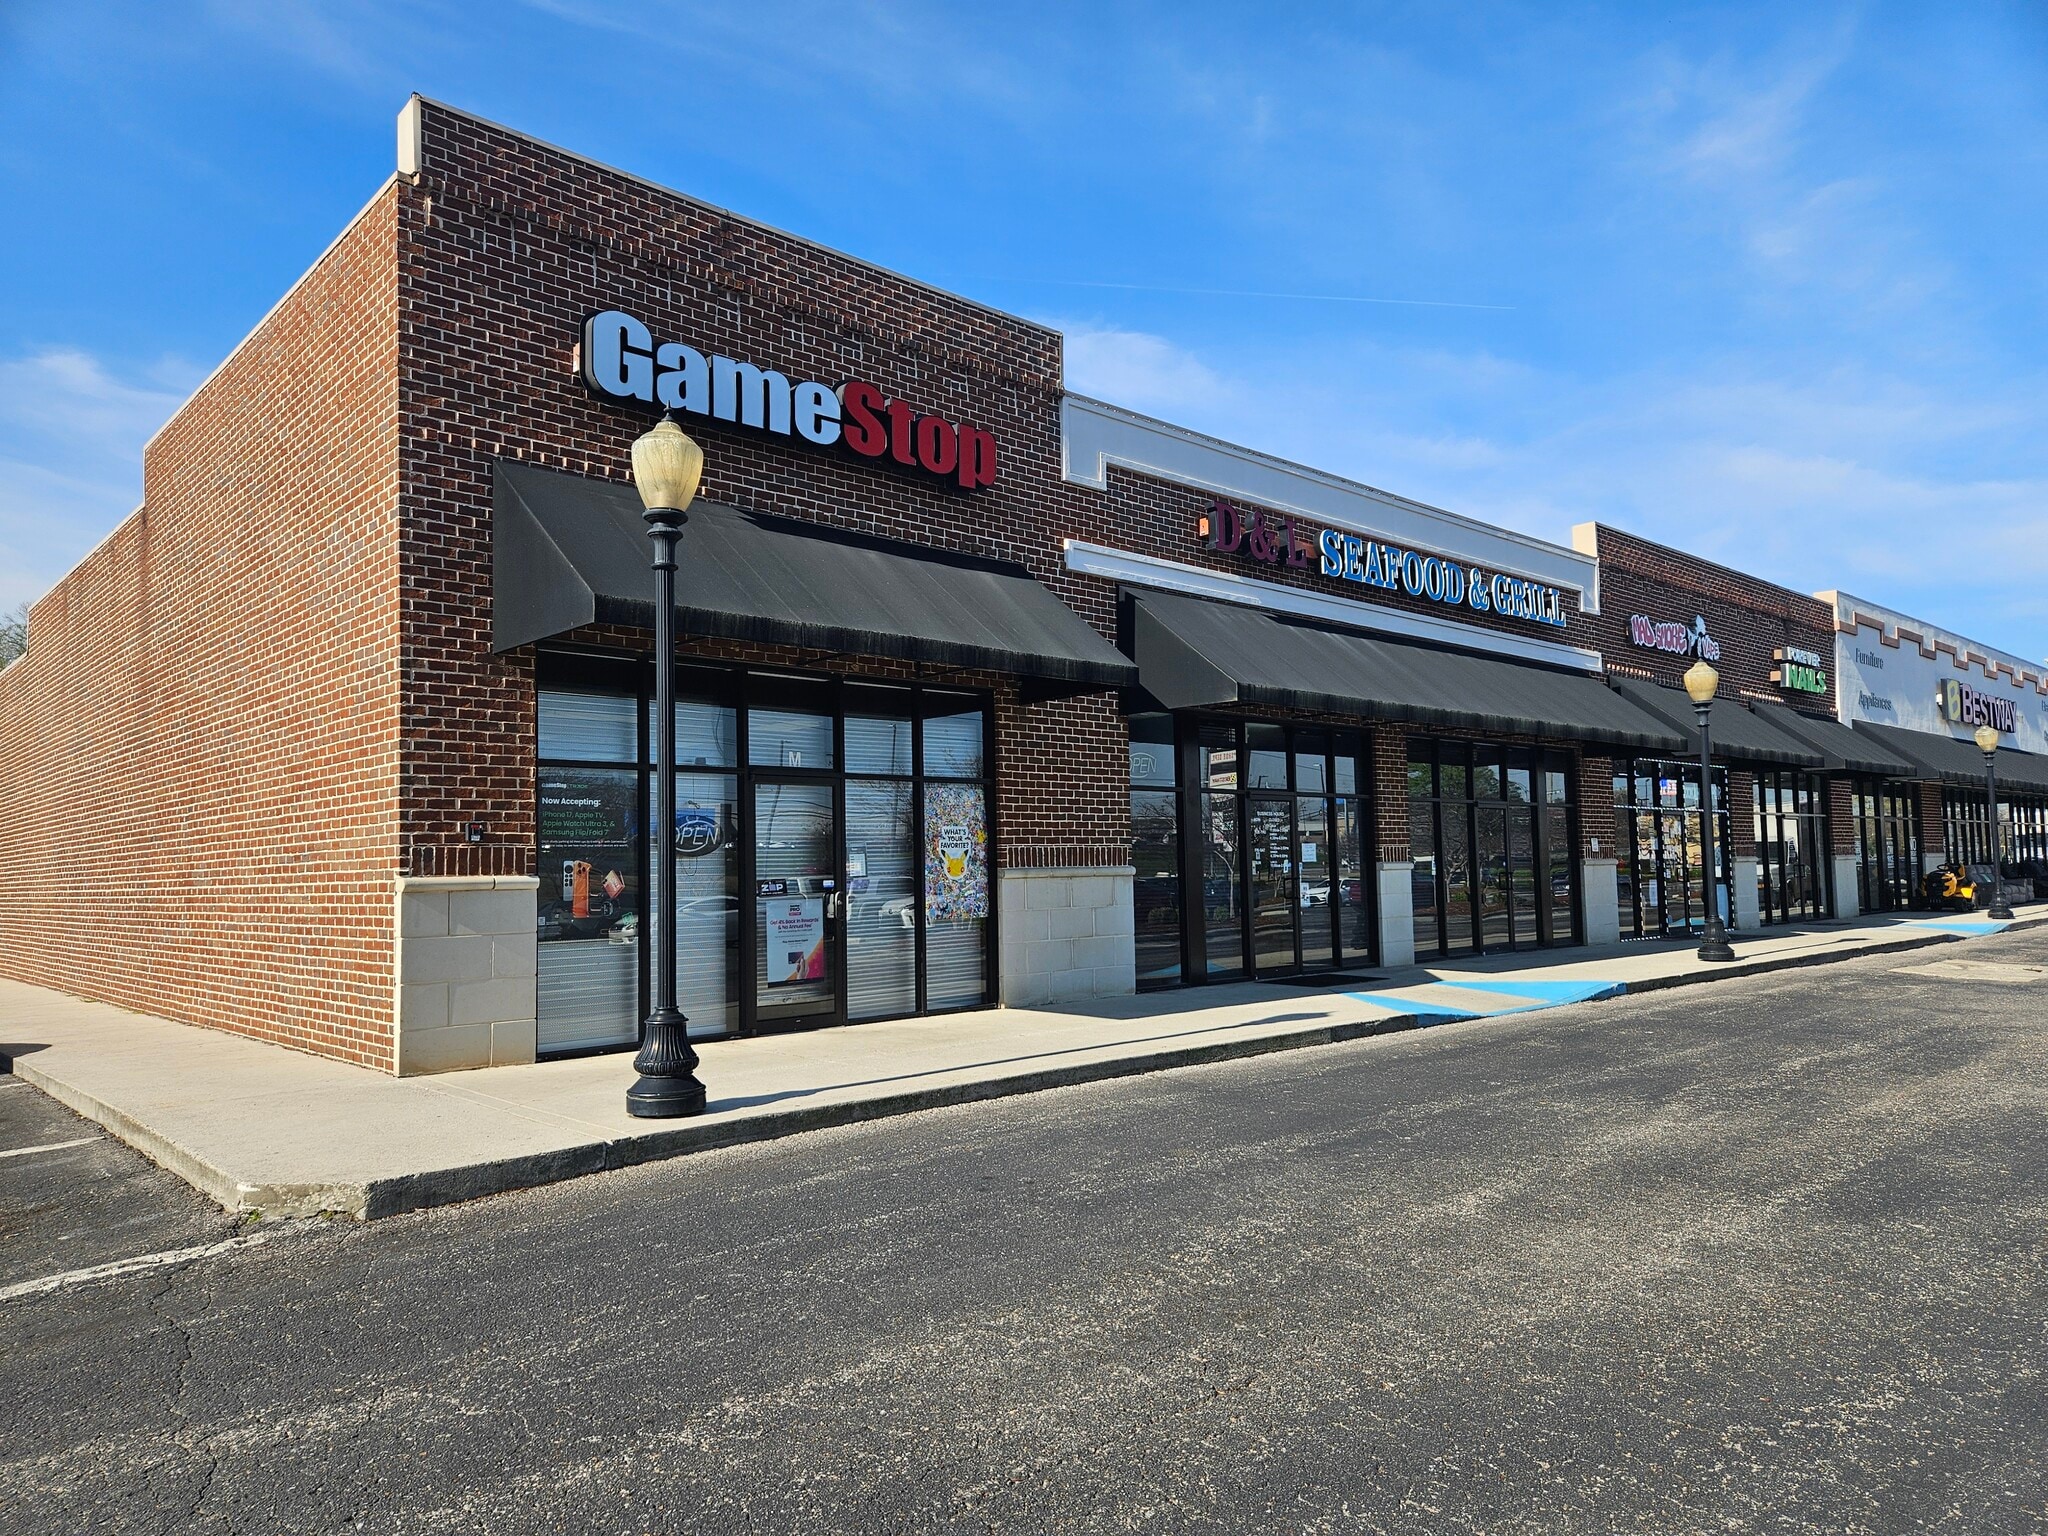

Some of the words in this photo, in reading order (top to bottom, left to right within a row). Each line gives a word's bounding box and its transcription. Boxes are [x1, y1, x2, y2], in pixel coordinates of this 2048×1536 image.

[587, 309, 997, 489] GameStop
[1318, 529, 1464, 605] SEAFOOD
[1467, 567, 1490, 611] &
[1492, 574, 1567, 628] GRILL
[1631, 614, 1656, 647] MAD
[1655, 622, 1688, 655] SMOKE
[1788, 646, 1821, 668] FOREVER
[1855, 647, 1884, 670] Furniture
[1786, 662, 1827, 694] NAILS
[1858, 690, 1892, 711] Appliances
[1962, 683, 2017, 733] BESTWAY
[788, 751, 801, 767] M
[1129, 758, 1157, 774] PEN
[541, 797, 560, 805] Now
[560, 797, 602, 808] Accepting:
[542, 810, 566, 818] iPhone
[574, 811, 594, 820] Apple
[542, 820, 562, 828] Apple
[541, 829, 574, 837] Samsung
[575, 828, 603, 837] Flip/Fold
[943, 828, 967, 836] WHAT'S
